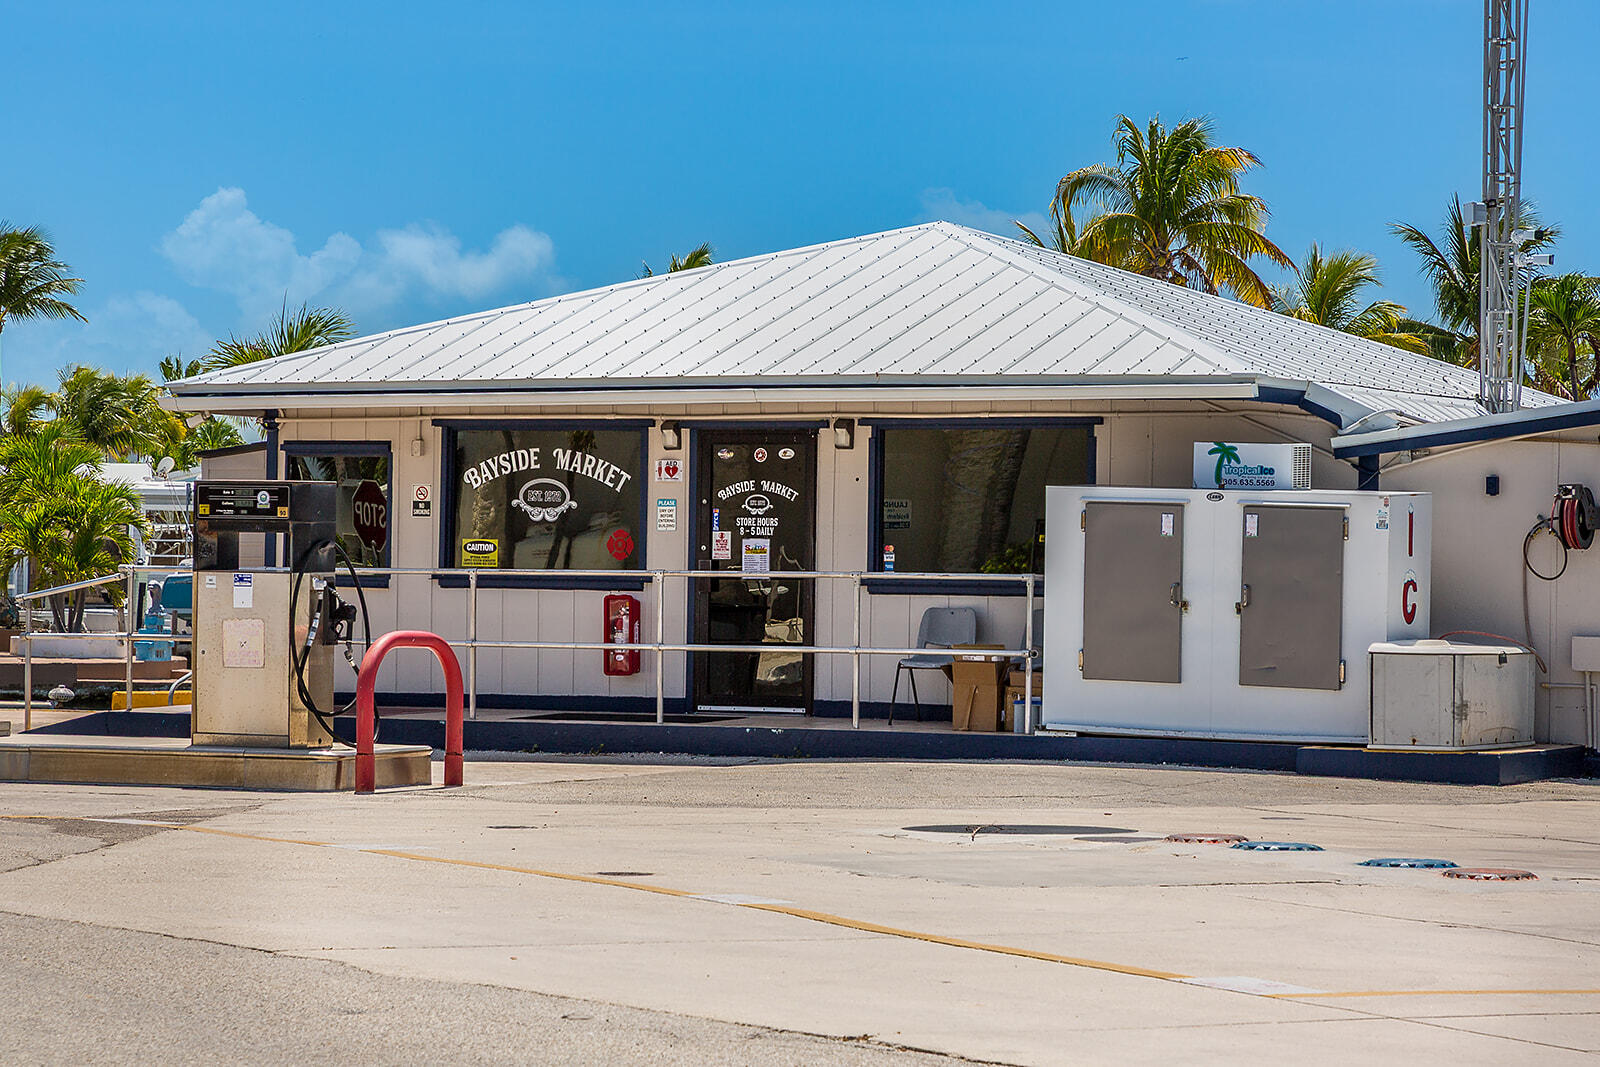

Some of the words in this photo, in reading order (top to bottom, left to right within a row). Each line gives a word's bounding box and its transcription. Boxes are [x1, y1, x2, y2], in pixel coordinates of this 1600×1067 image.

[463, 447, 540, 490] BAYSIDE
[552, 447, 631, 494] MARKET
[1224, 478, 1275, 486] 305.635.5569
[717, 480, 756, 501] BAYSIDE
[760, 480, 799, 502] MARKET
[735, 517, 757, 527] STORE
[757, 517, 779, 527] HOURS
[739, 527, 745, 536] 8
[750, 527, 756, 536] 5
[756, 527, 774, 536] DAILY
[466, 543, 494, 552] CAUTION
